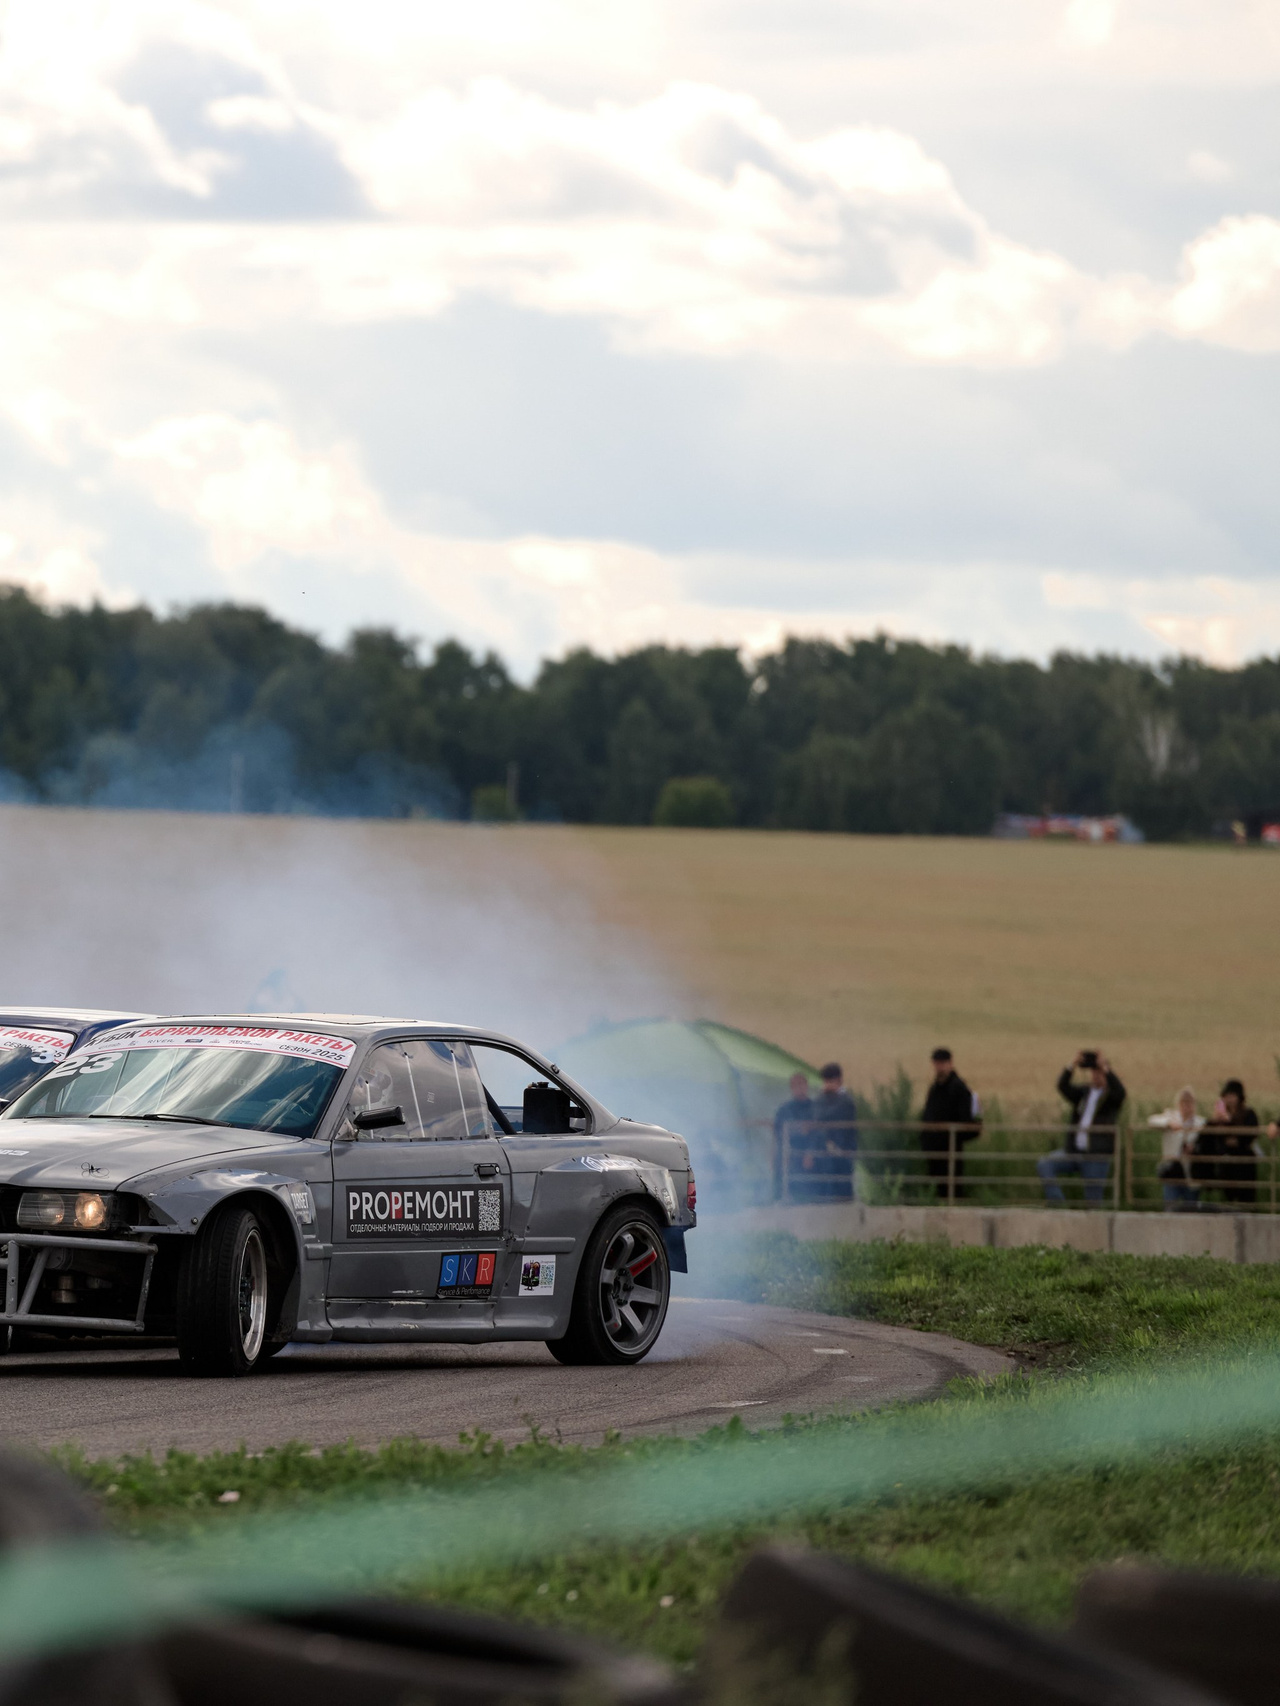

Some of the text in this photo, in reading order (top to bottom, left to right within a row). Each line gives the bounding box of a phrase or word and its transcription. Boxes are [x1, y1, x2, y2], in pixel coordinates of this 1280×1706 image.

[3, 1028, 72, 1049] РАКЕТЫ
[276, 1030, 354, 1052] РАКЕТЫ
[279, 1044, 346, 1061] СЕЗОН 2025
[44, 1052, 123, 1079] 23
[350, 1223, 387, 1233] ОТДЕЛОЧНЫЕ
[421, 1222, 443, 1232] ПОДБОР
[443, 1222, 449, 1231] И
[449, 1222, 475, 1232] ПРОДАЖА
